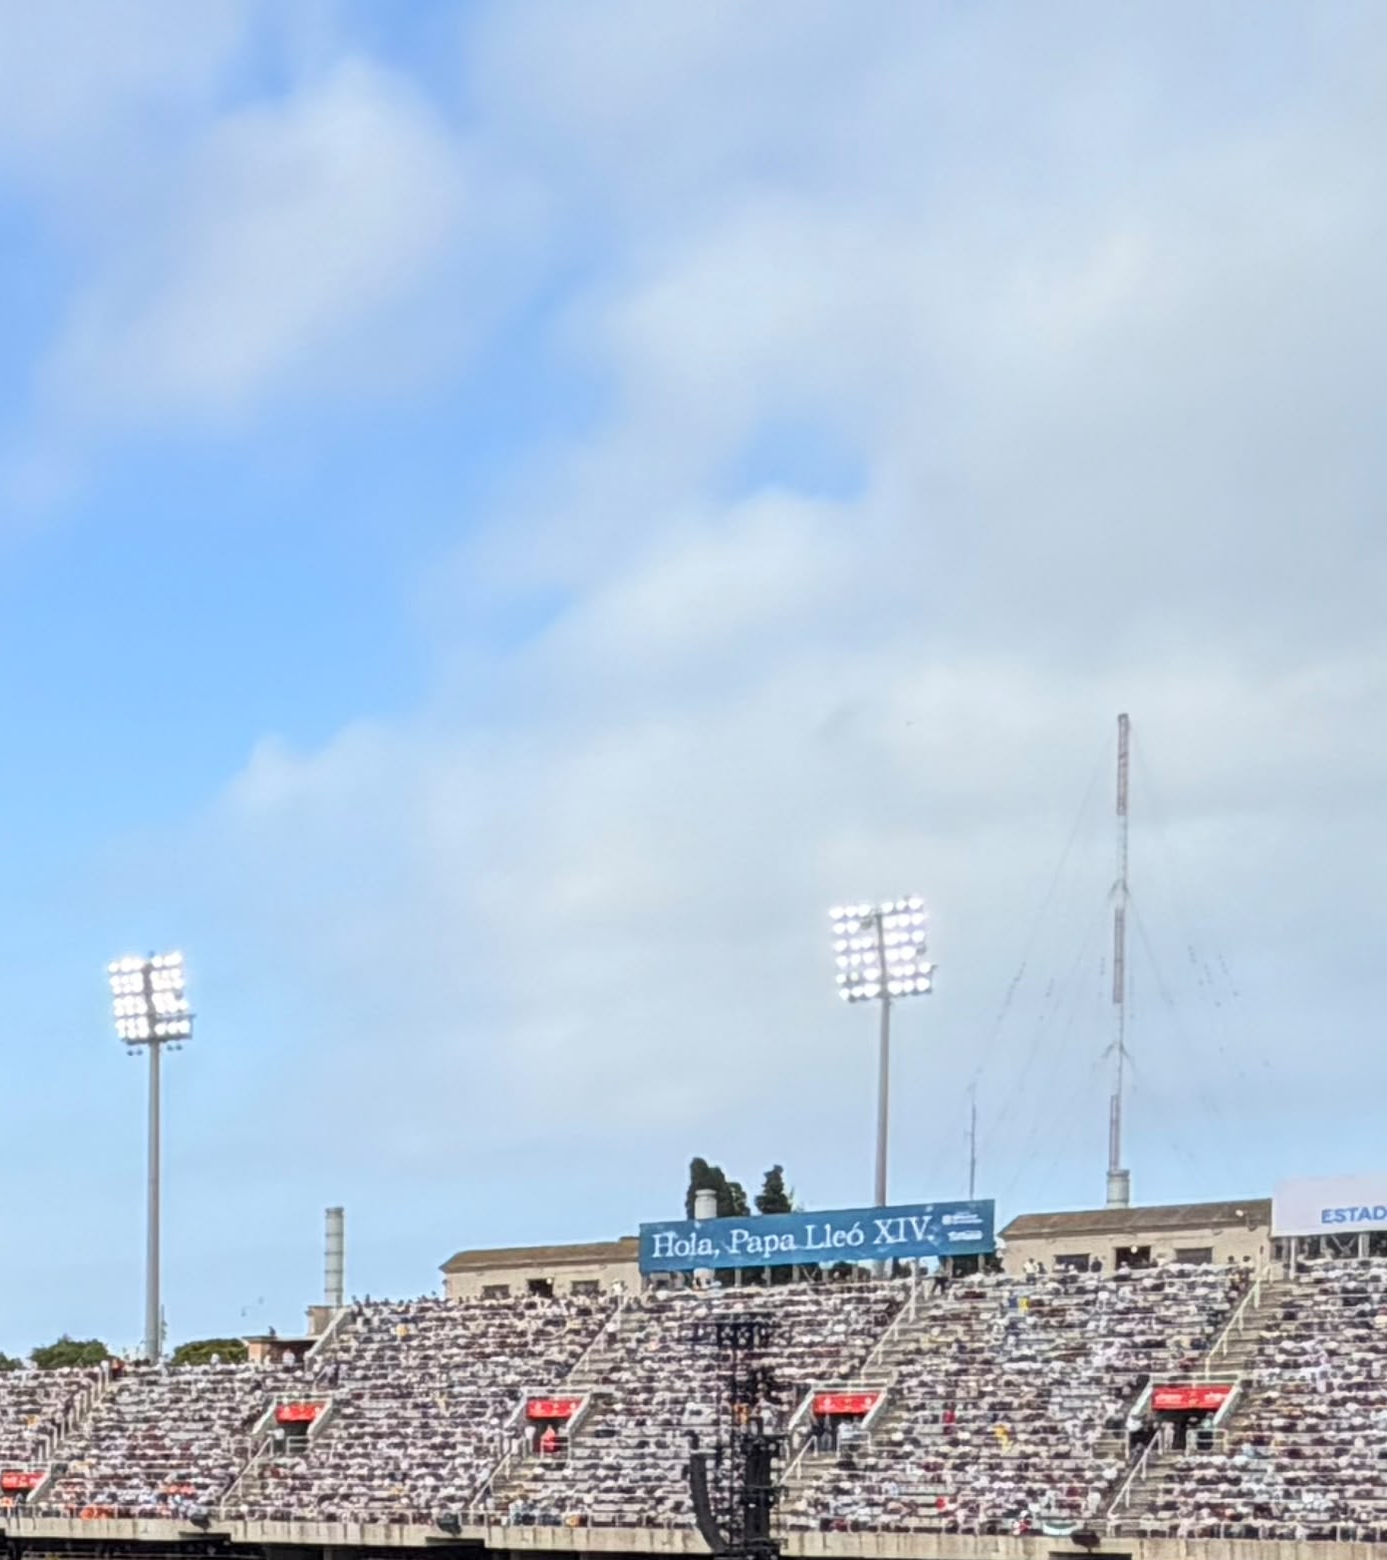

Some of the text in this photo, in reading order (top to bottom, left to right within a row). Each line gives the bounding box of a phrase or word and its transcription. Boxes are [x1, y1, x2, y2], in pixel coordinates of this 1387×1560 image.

[652, 1231, 720, 1259] Hola,
[730, 1228, 797, 1258] Papa
[805, 1221, 864, 1250] Lleó
[873, 1215, 934, 1245] XIV.
